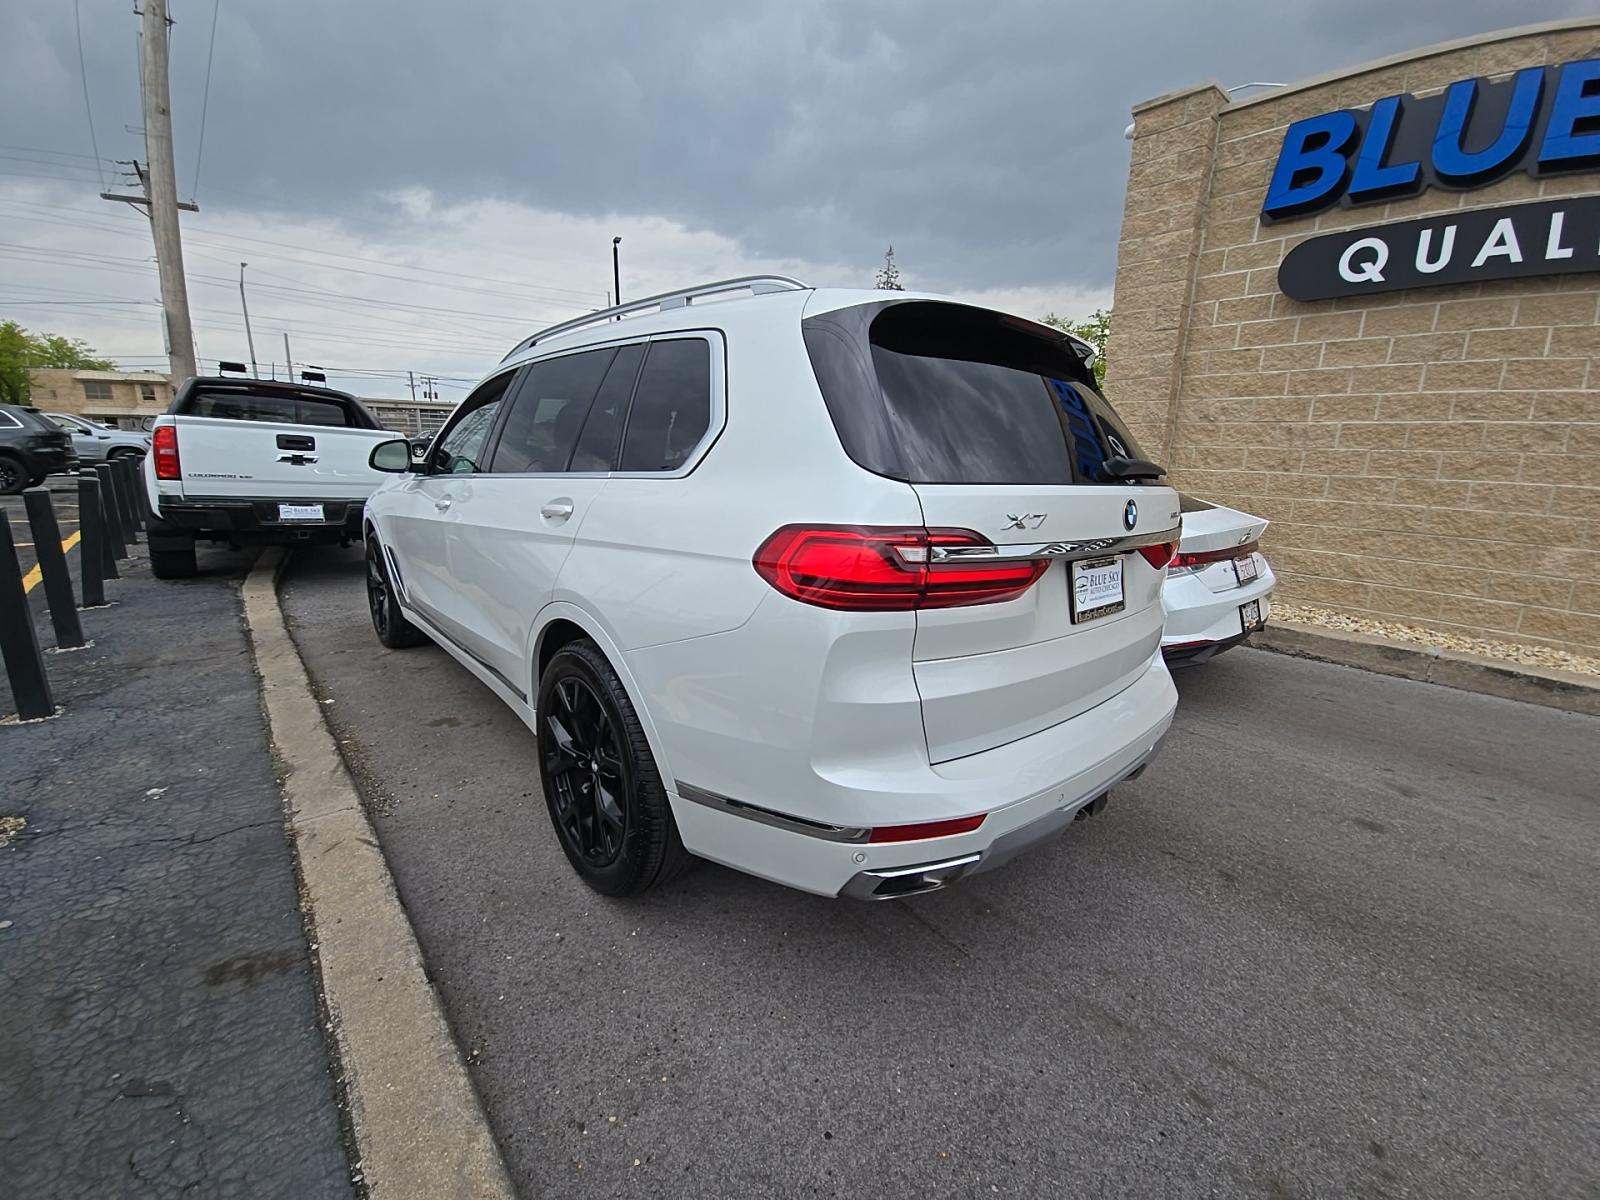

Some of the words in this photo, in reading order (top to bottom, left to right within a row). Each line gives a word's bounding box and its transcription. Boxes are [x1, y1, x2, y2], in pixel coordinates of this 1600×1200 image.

[1263, 58, 1600, 214] BLUE
[1338, 211, 1600, 283] QUAL
[1000, 513, 1047, 530] X7
[1089, 574, 1107, 588] BLUE
